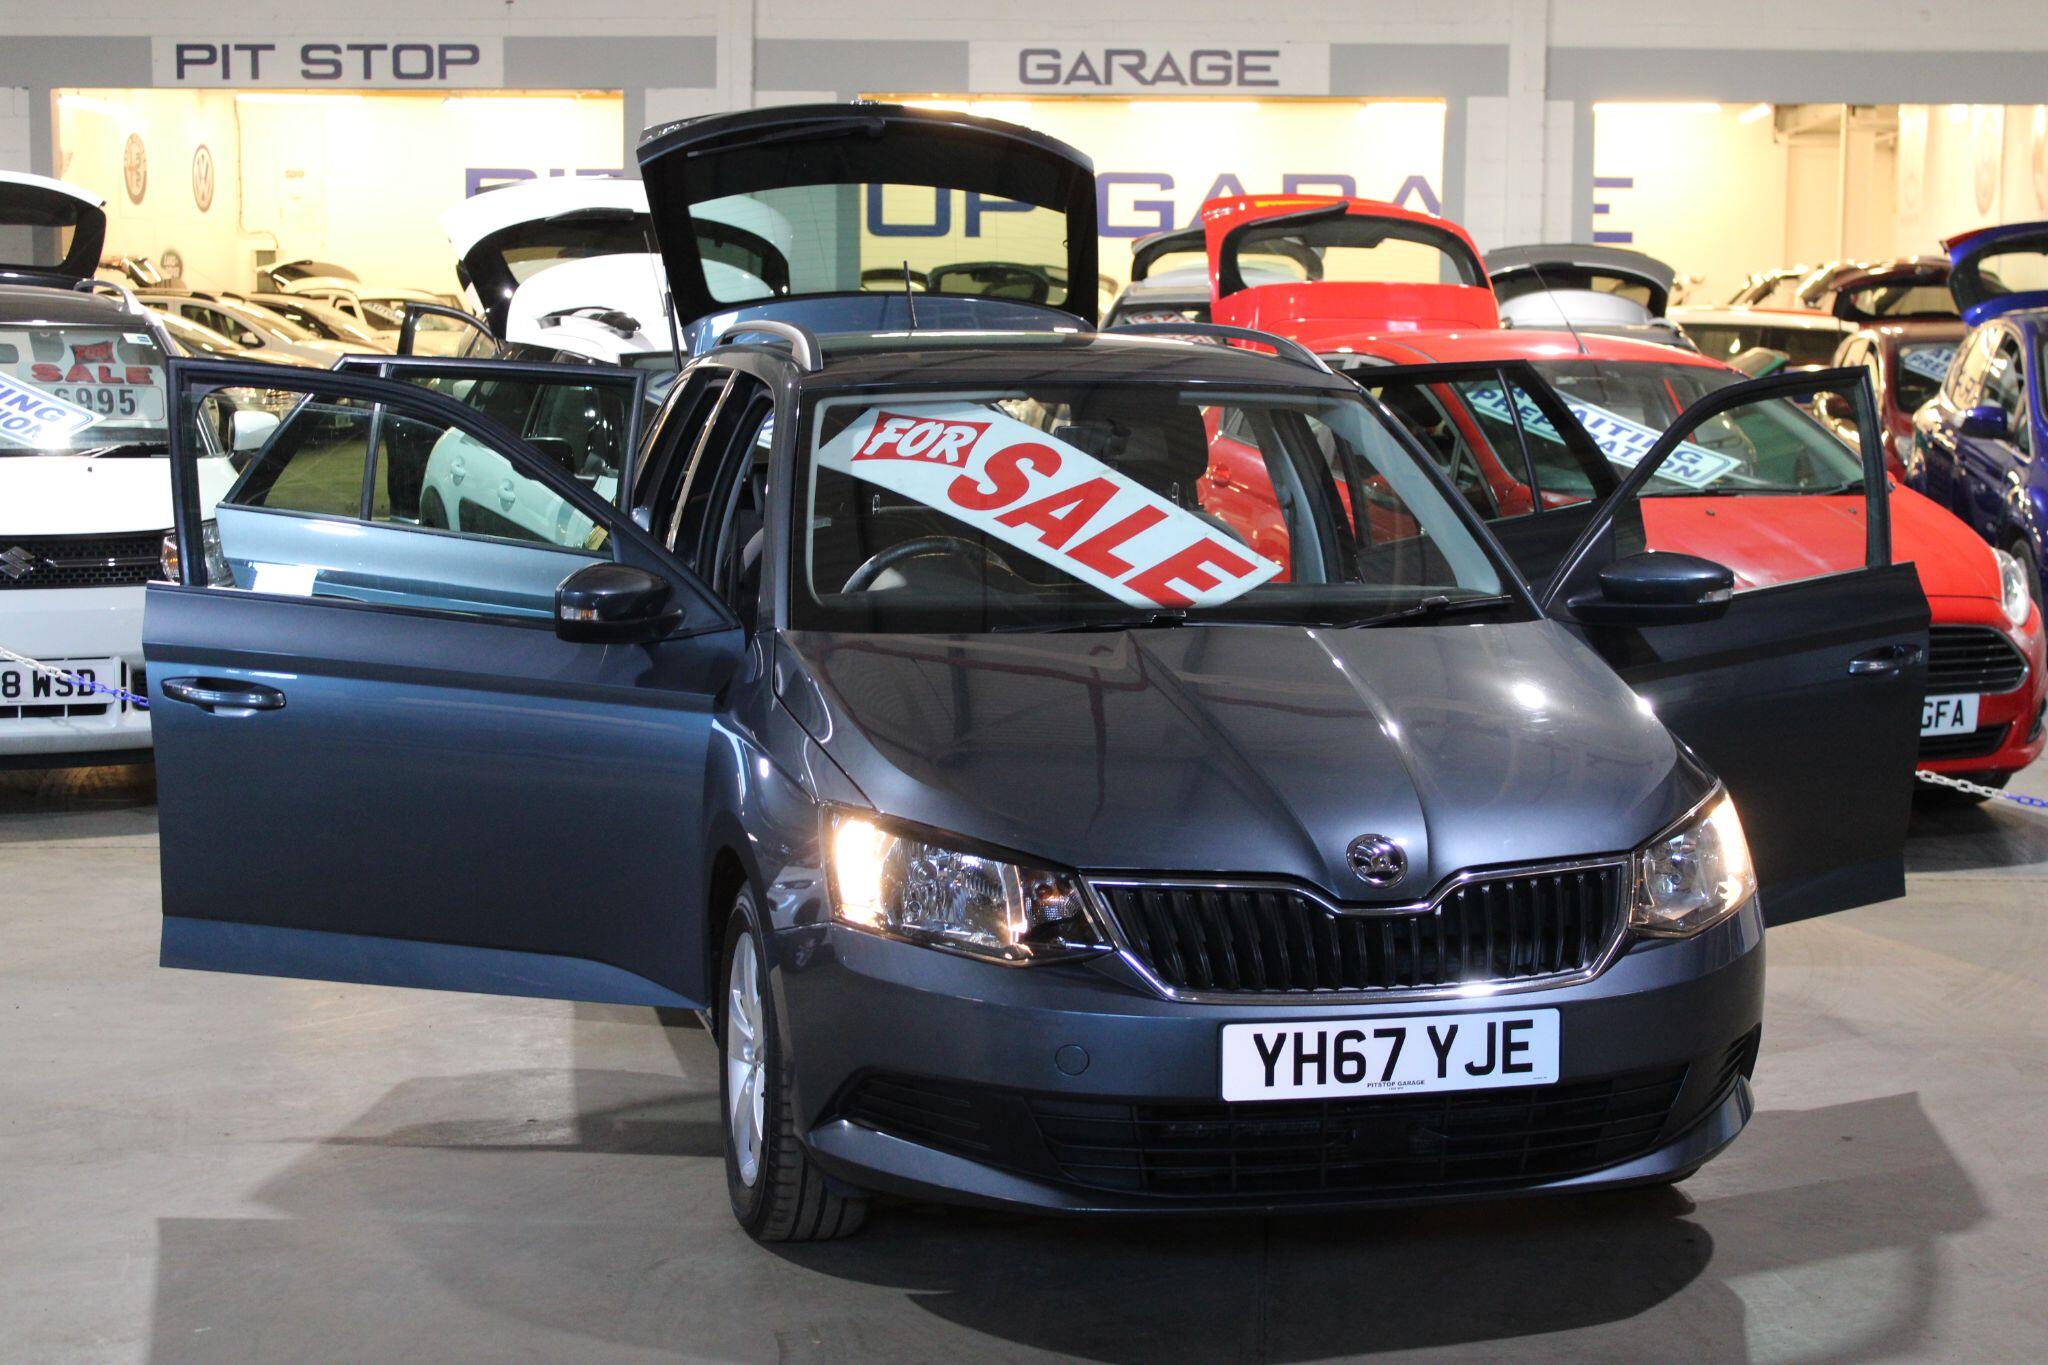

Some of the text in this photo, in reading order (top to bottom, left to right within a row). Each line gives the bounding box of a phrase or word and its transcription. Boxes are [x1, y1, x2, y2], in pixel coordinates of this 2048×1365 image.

[175, 43, 481, 81] PIT STOP
[1018, 47, 1281, 87] GARAGE
[31, 363, 154, 385] SALE
[0, 383, 66, 423] ING
[864, 416, 1259, 608] FOR SALE
[33, 668, 97, 698] WSD
[1921, 699, 1964, 729] GFA
[1252, 1018, 1534, 1088] YH67 YJE
[1397, 1079, 1426, 1087] GARAGE
